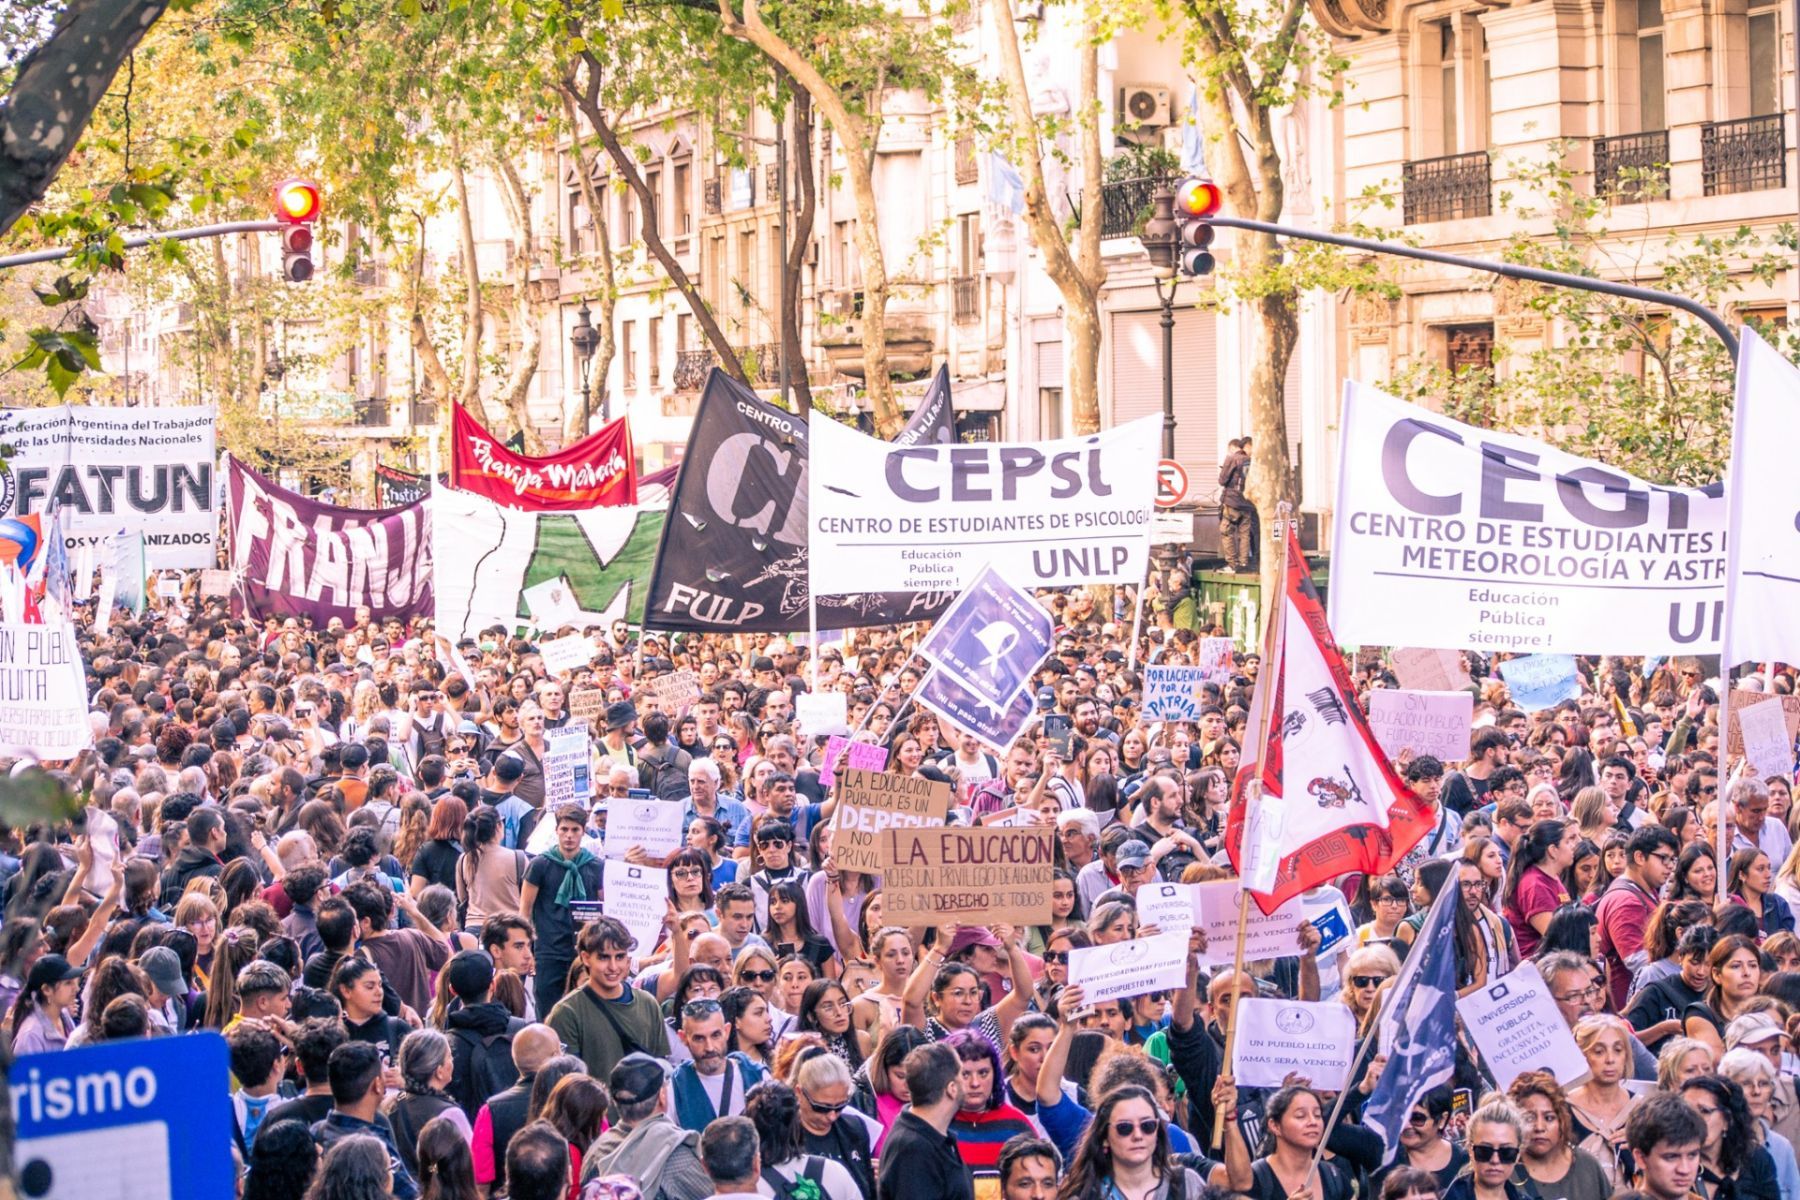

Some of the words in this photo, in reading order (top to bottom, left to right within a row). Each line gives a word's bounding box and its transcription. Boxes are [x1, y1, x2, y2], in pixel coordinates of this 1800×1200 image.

[69, 416, 129, 432] Argentina
[132, 421, 150, 430] del
[152, 416, 213, 430] Trabajador
[737, 401, 792, 433] CENTRO
[14, 438, 29, 448] de
[32, 436, 49, 447] las
[52, 433, 136, 446] Universidades
[139, 433, 202, 446] Nacionales
[15, 462, 212, 516] FATUN
[818, 516, 893, 534] CENTRO
[900, 517, 923, 534] DE
[929, 514, 1045, 533] ESTUDIANTES
[1050, 513, 1070, 529] DE
[1350, 511, 1466, 543] CENTRO
[1476, 524, 1514, 546] DE
[1522, 526, 1714, 555] ESTUDIANTES
[901, 548, 962, 560] Educación
[1032, 546, 1129, 579] UNLP
[1402, 545, 1629, 580] METEOROLOGÍA
[1640, 560, 1656, 580] Y
[904, 577, 952, 590] siempre
[663, 582, 764, 626] FULP
[1468, 588, 1559, 606] Educación
[1480, 610, 1546, 626] Pública
[1468, 631, 1540, 648] siempre
[1547, 631, 1552, 646] !
[1147, 669, 1164, 682] POR
[1150, 683, 1156, 693] Y
[1161, 684, 1177, 692] POR
[1181, 684, 1192, 694] LA
[1148, 696, 1195, 717] PATRIA
[1404, 694, 1427, 711] SIN
[947, 702, 957, 712] un
[958, 709, 976, 724] paso
[1386, 728, 1425, 743] FUTURO
[1427, 732, 1443, 744] ES
[1447, 733, 1462, 744] DE
[844, 771, 864, 789] LA
[846, 787, 894, 809] PÚBLICA
[897, 796, 911, 810] ES
[914, 798, 929, 812] UN
[850, 830, 873, 846] NO
[893, 830, 928, 866] LA
[612, 880, 660, 890] UNIVERSIDAD
[916, 869, 935, 888] UN
[940, 865, 996, 887] PRIVILEGIO
[999, 866, 1012, 885] DE
[888, 894, 904, 912] ES
[911, 894, 931, 912] UN
[933, 892, 988, 911] DERECHO
[992, 892, 1006, 908] DE
[1008, 892, 1044, 907] TODOS
[1210, 920, 1225, 929] UN
[1154, 958, 1182, 968] FUTURO
[1146, 978, 1157, 986] YA!
[1478, 989, 1536, 1026] UNIVERSIDAD
[1496, 1009, 1535, 1034] PÚBLICA
[1268, 1040, 1304, 1050] PUEBLO
[1492, 1034, 1539, 1064] INCLUSIVA
[1538, 1031, 1546, 1043] Y
[1548, 1022, 1560, 1036] DE
[1511, 1040, 1551, 1066] CALIDAD
[1304, 1058, 1347, 1068] VENCIDO
[8, 1066, 156, 1123] rismo
